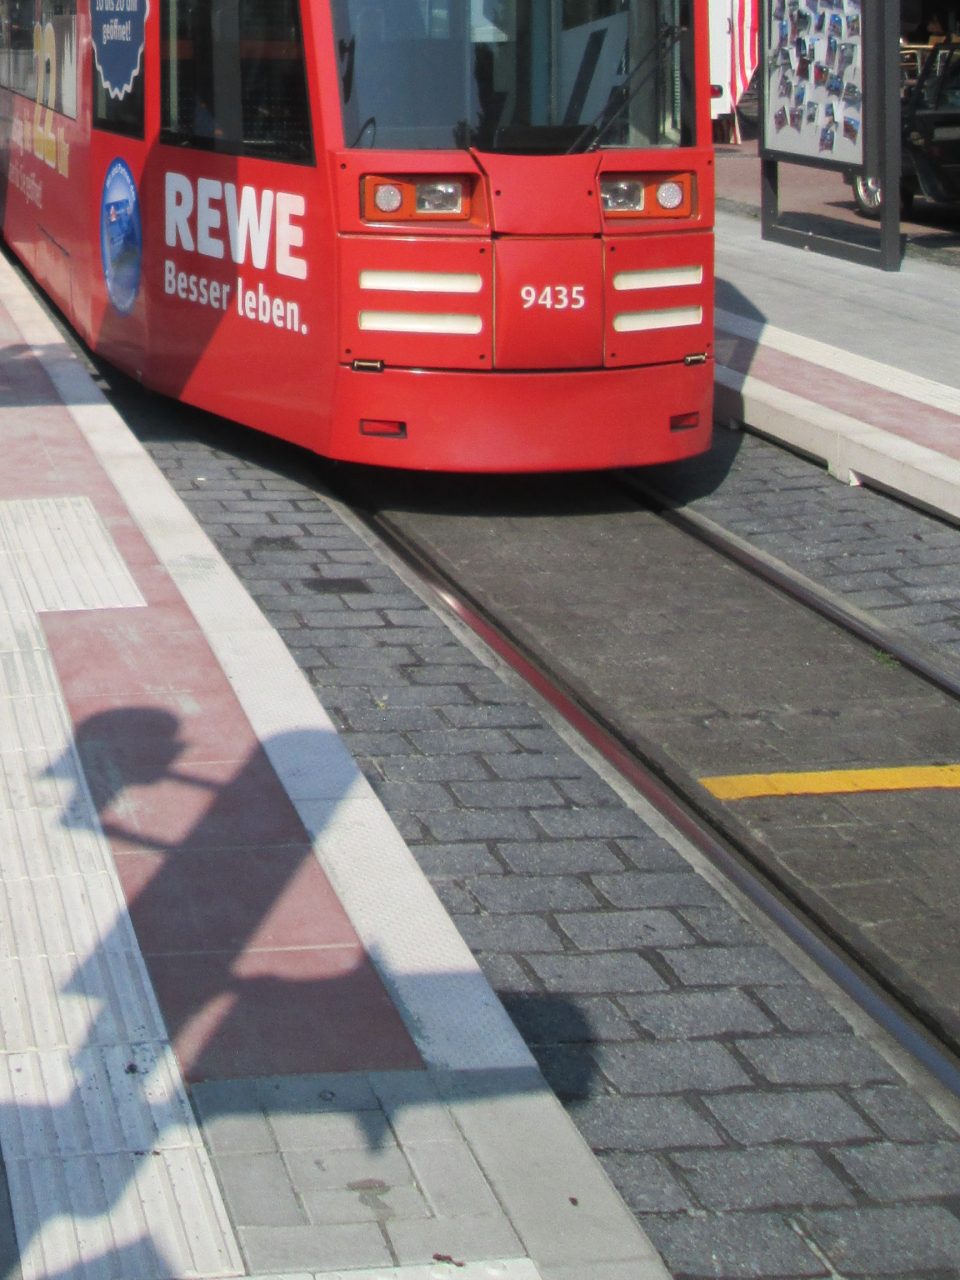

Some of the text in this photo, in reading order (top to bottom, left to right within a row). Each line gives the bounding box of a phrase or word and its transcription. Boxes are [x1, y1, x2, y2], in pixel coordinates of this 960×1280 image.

[102, 19, 132, 45] geöffnet!
[164, 171, 308, 281] REWE
[164, 259, 231, 311] Besser
[237, 276, 308, 335] leben.
[520, 285, 586, 310] 9435
